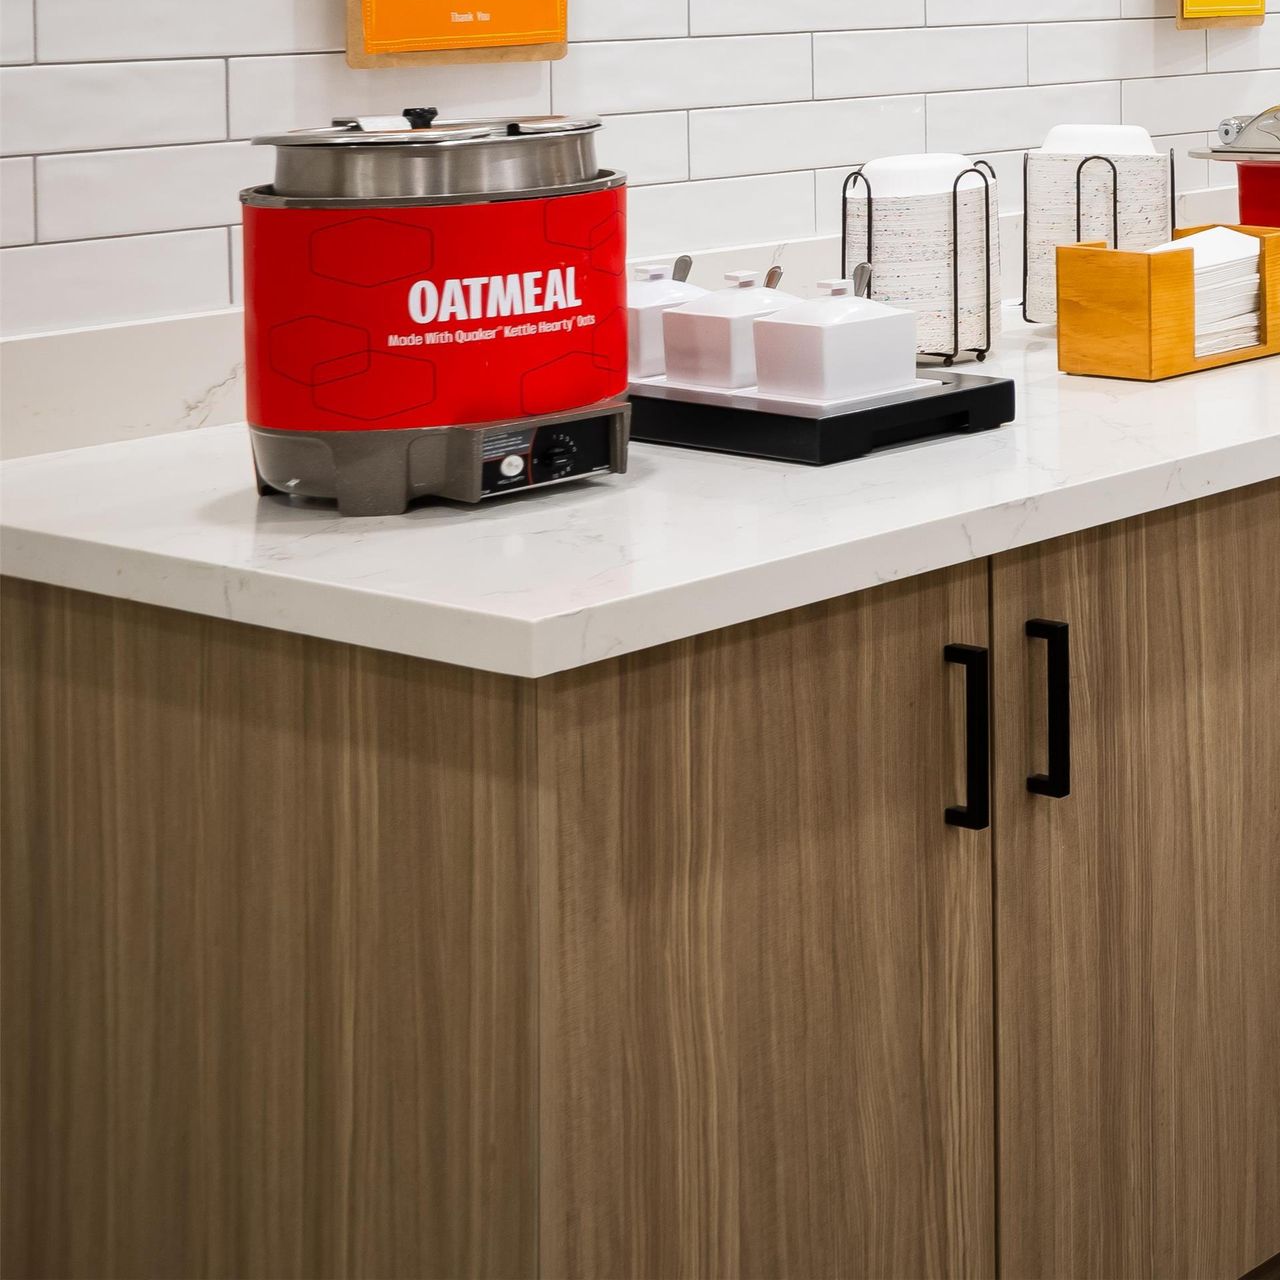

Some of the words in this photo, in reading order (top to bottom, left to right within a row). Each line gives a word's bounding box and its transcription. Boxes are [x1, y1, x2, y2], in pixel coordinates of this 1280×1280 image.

[450, 11, 474, 23] Thank
[476, 11, 491, 22] You
[407, 266, 582, 325] OATMEAL
[388, 334, 423, 347] Made
[425, 332, 453, 345] With
[504, 322, 537, 338] Kettle
[576, 314, 596, 328] Oats
